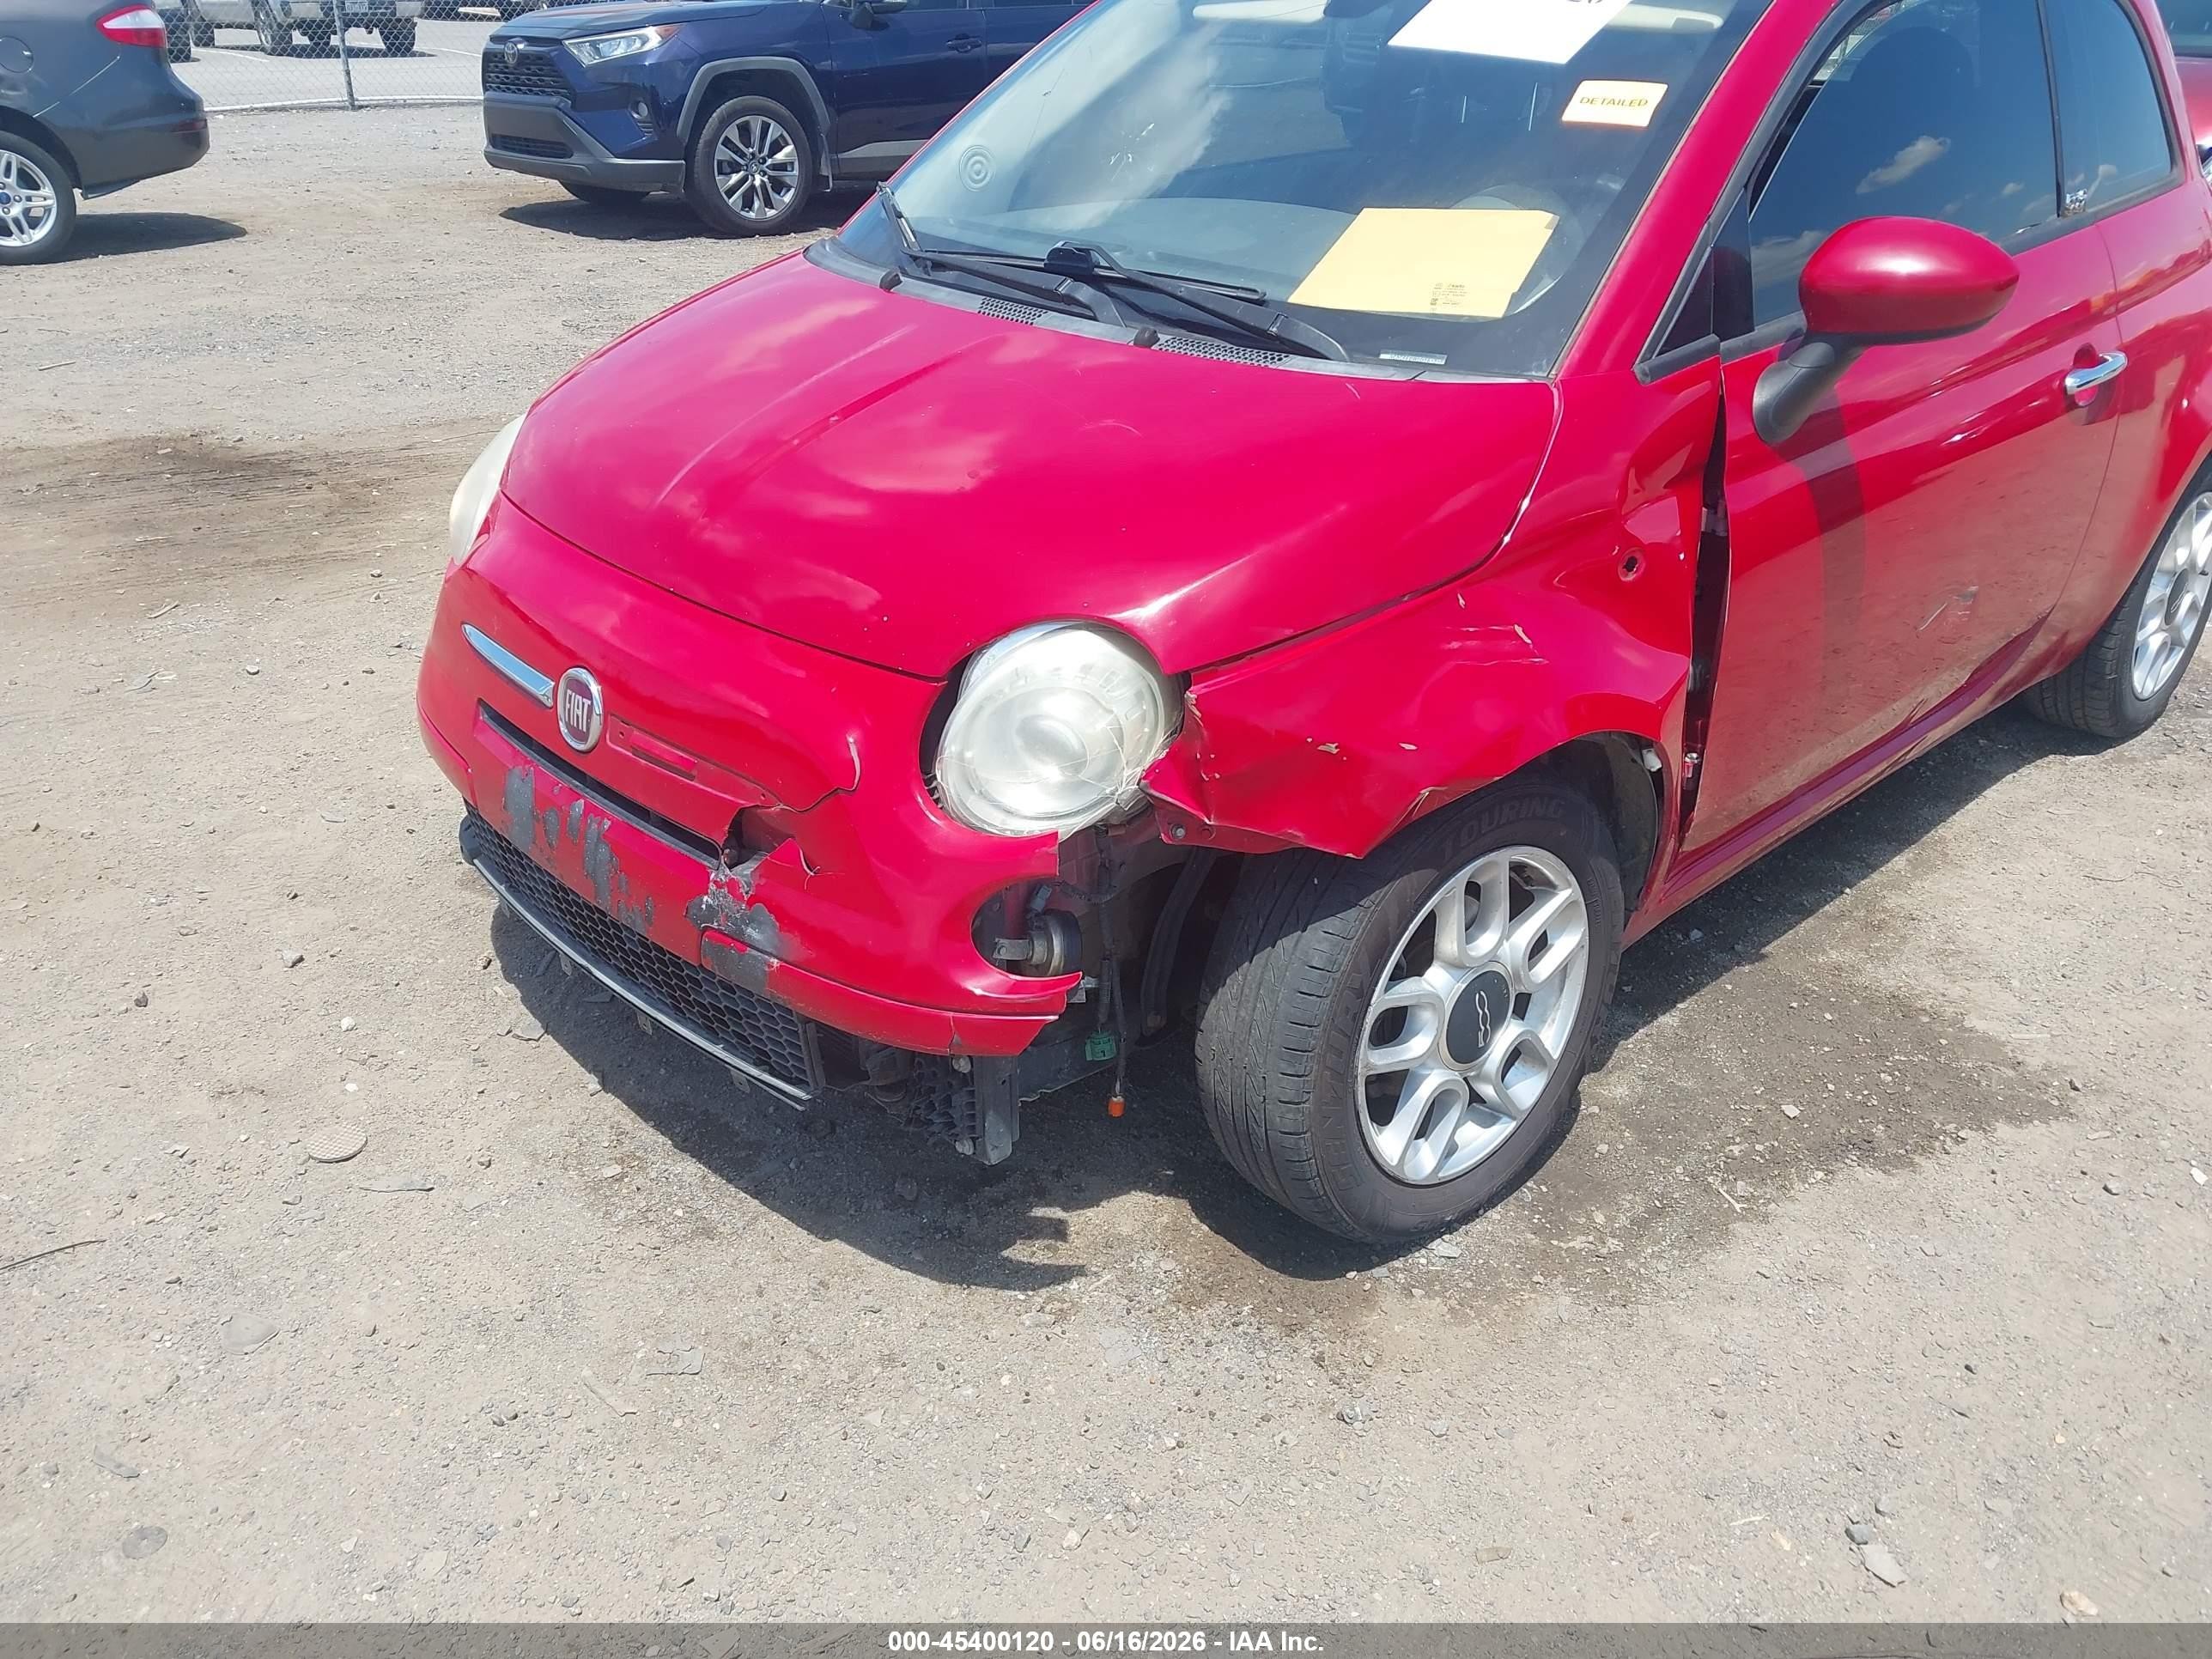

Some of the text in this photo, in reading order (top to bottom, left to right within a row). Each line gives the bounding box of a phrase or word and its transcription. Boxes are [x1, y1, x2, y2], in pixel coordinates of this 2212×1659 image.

[1579, 96, 1649, 107] DETAILED
[565, 689, 592, 732] FIAT
[1475, 989, 1492, 1048] 500
